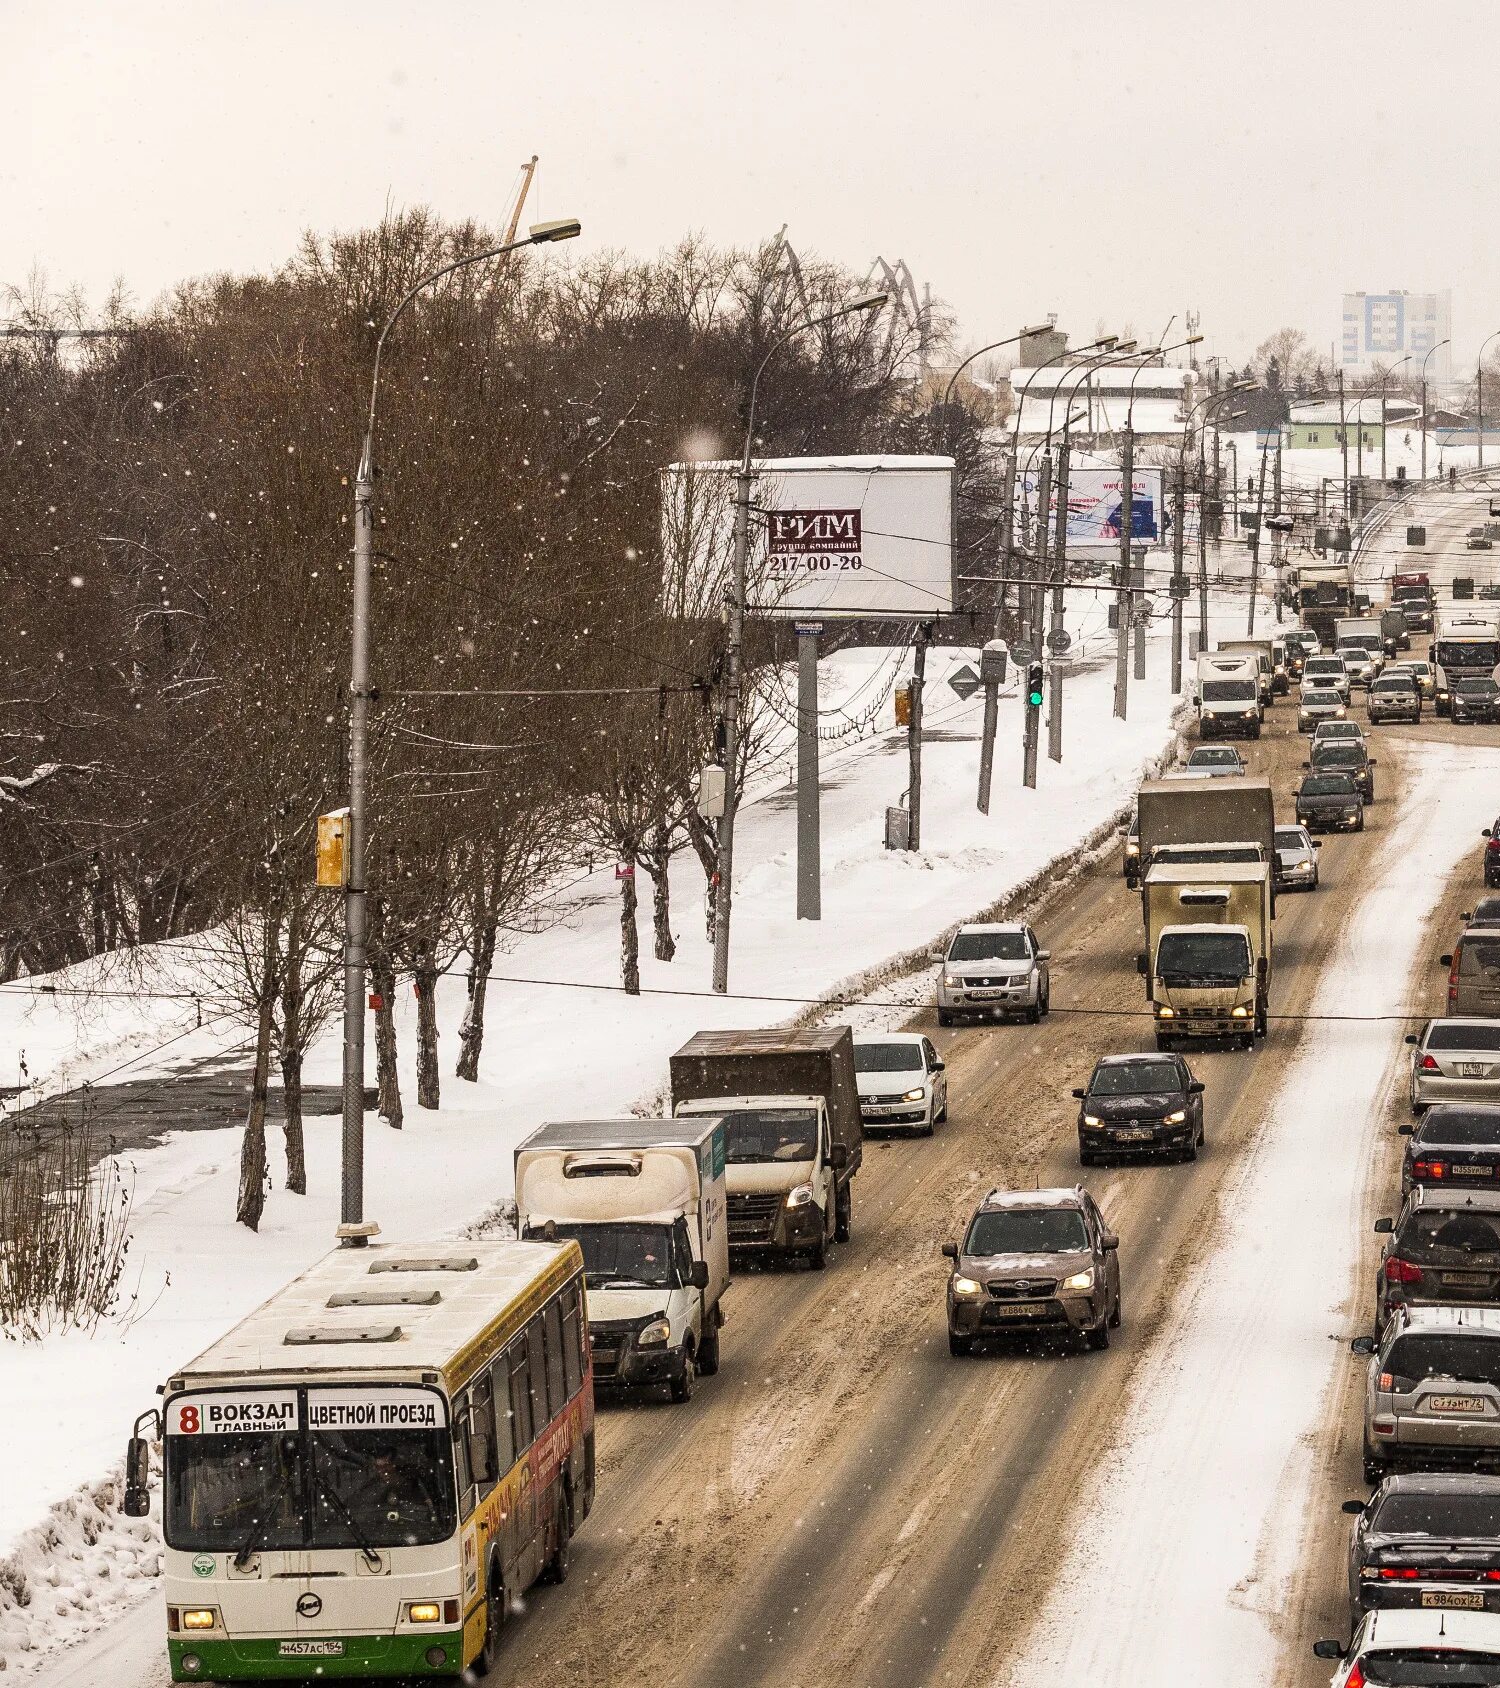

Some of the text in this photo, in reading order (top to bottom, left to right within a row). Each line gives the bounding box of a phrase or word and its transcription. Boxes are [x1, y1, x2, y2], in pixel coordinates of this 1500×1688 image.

[773, 514, 857, 539] РИМ
[809, 541, 859, 549] компаний
[770, 555, 862, 570] 217-00-20
[179, 1406, 200, 1433] 8
[209, 1403, 294, 1421] ВОКЗАЛ
[310, 1402, 436, 1425] ЦВЕТНОЙ ПРОЕЗД
[214, 1419, 287, 1433] ГЛАВНЫЙ
[1426, 1594, 1467, 1605] К984ОХ
[283, 1642, 323, 1654] Н457АС
